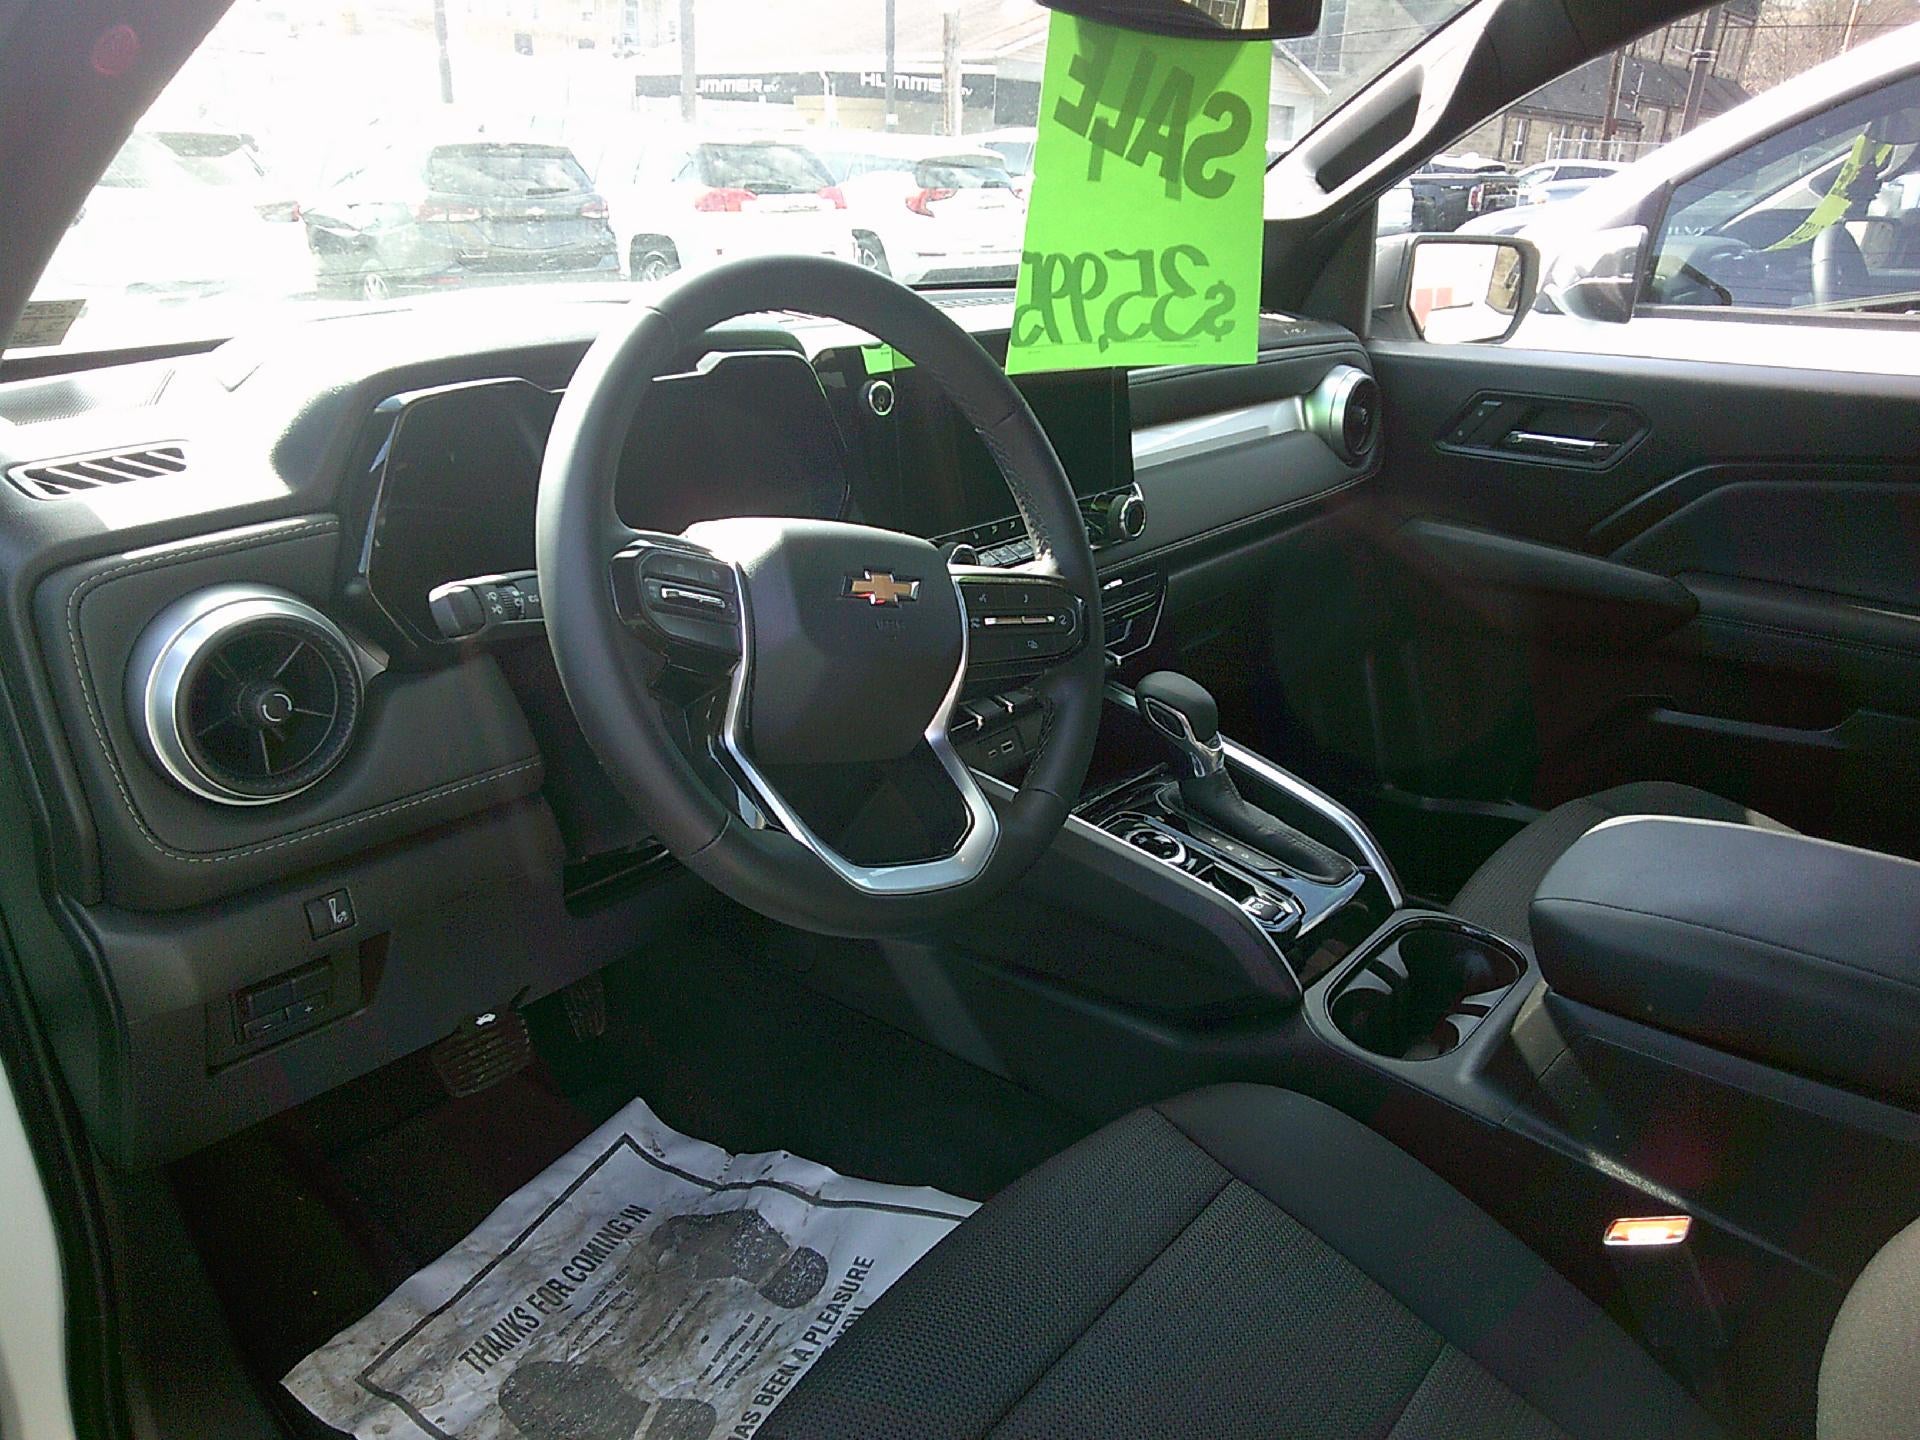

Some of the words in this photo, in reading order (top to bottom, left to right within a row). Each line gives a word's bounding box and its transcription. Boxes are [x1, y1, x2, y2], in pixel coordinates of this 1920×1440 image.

[680, 79, 763, 93] UMMER
[860, 71, 944, 93] HUMME
[458, 1305, 540, 1375] THANKS
[526, 1278, 576, 1315] FOR
[561, 1218, 634, 1283] COMING
[620, 1204, 652, 1225] IN
[802, 1255, 875, 1346] PLEASURE
[792, 1348, 815, 1362] A
[753, 1363, 801, 1407] BEEN
